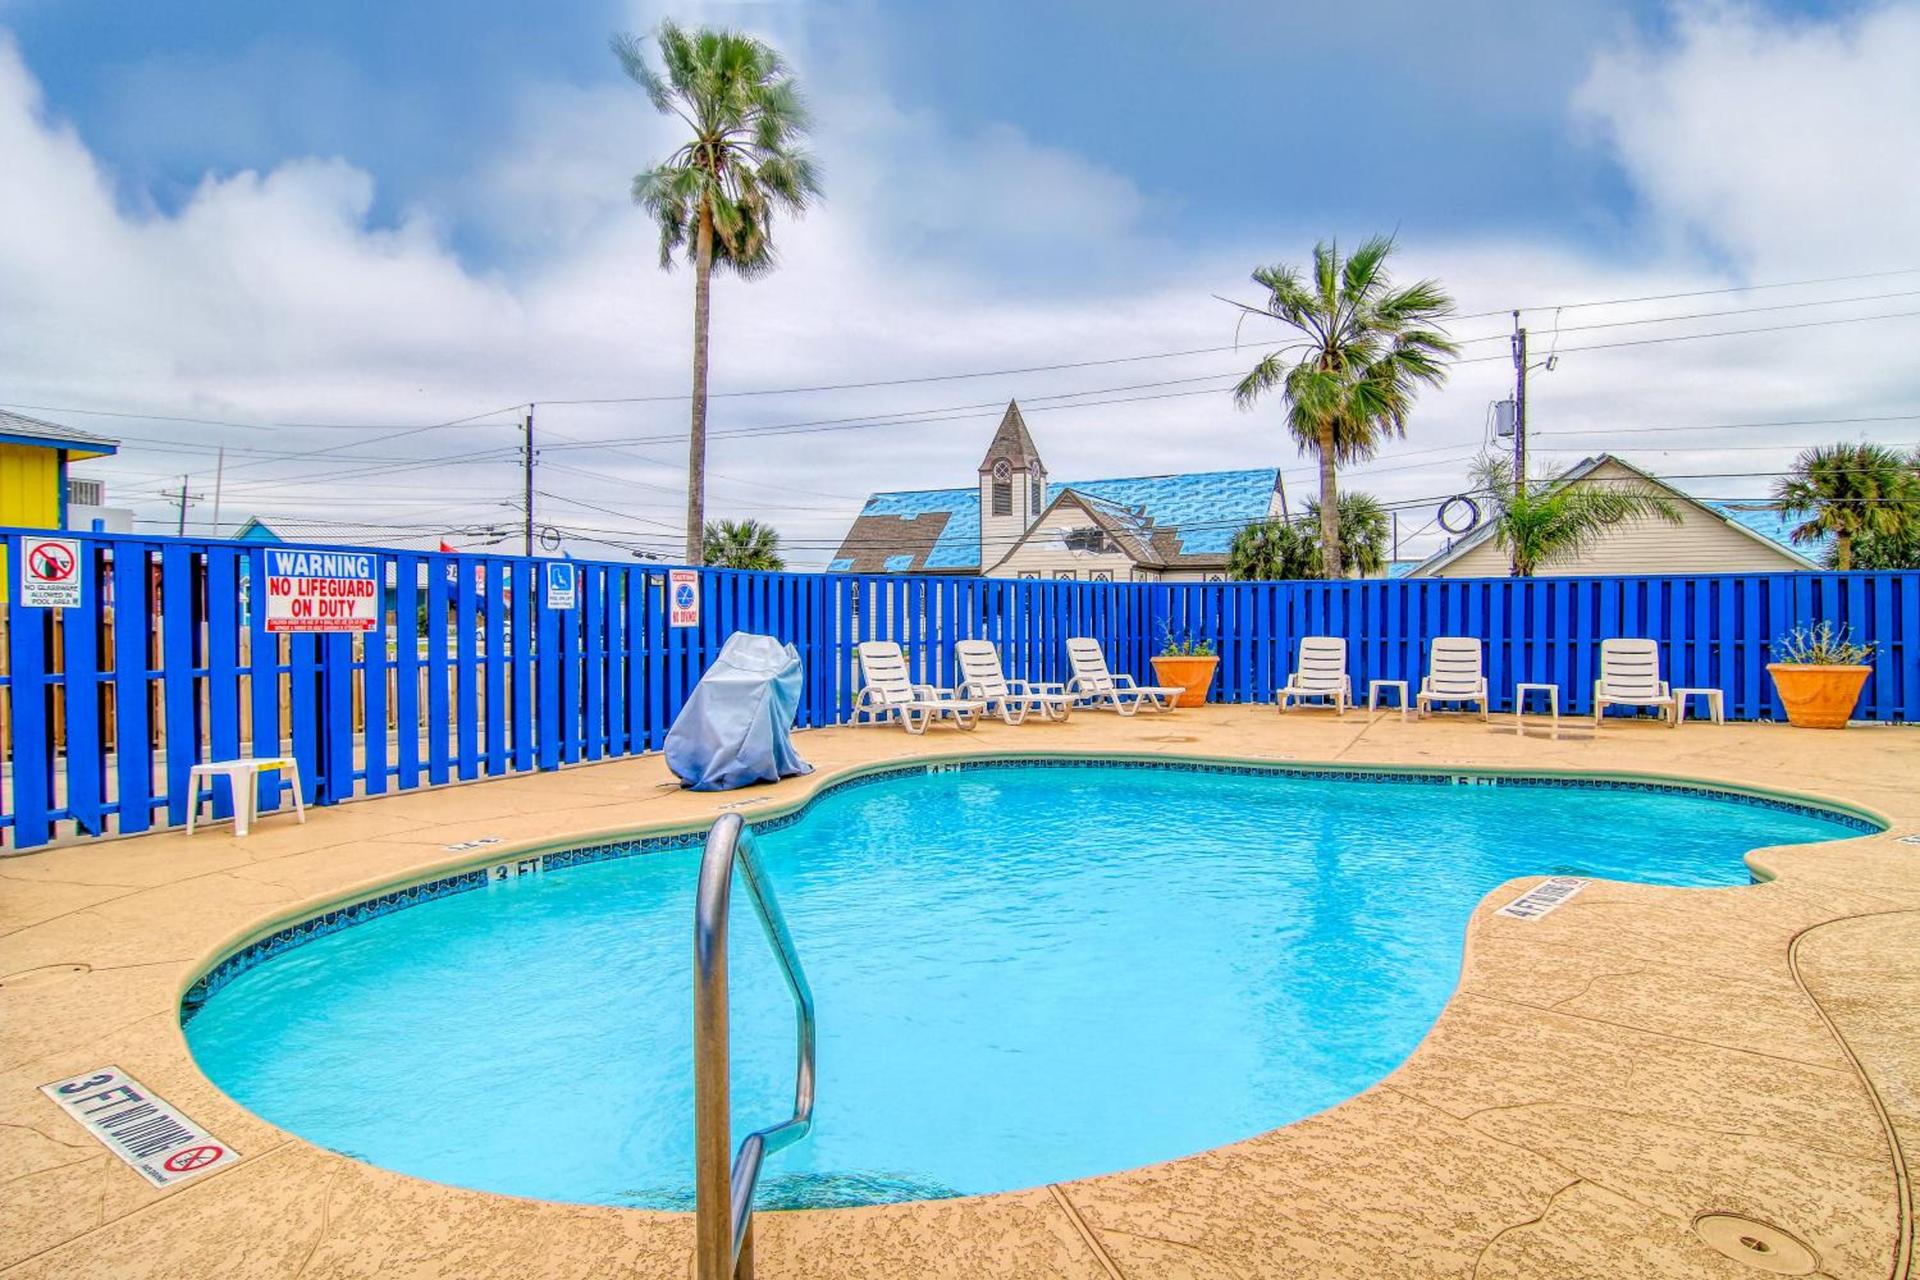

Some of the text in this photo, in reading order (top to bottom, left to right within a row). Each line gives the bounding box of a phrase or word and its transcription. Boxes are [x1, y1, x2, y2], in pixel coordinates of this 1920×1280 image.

[275, 552, 369, 578] WARNING
[270, 577, 374, 597] NO LIFEGUARD
[291, 599, 356, 617] ON DUTY
[496, 858, 540, 881] 3 FT
[58, 1074, 195, 1160] 3 FT NO DIVING
